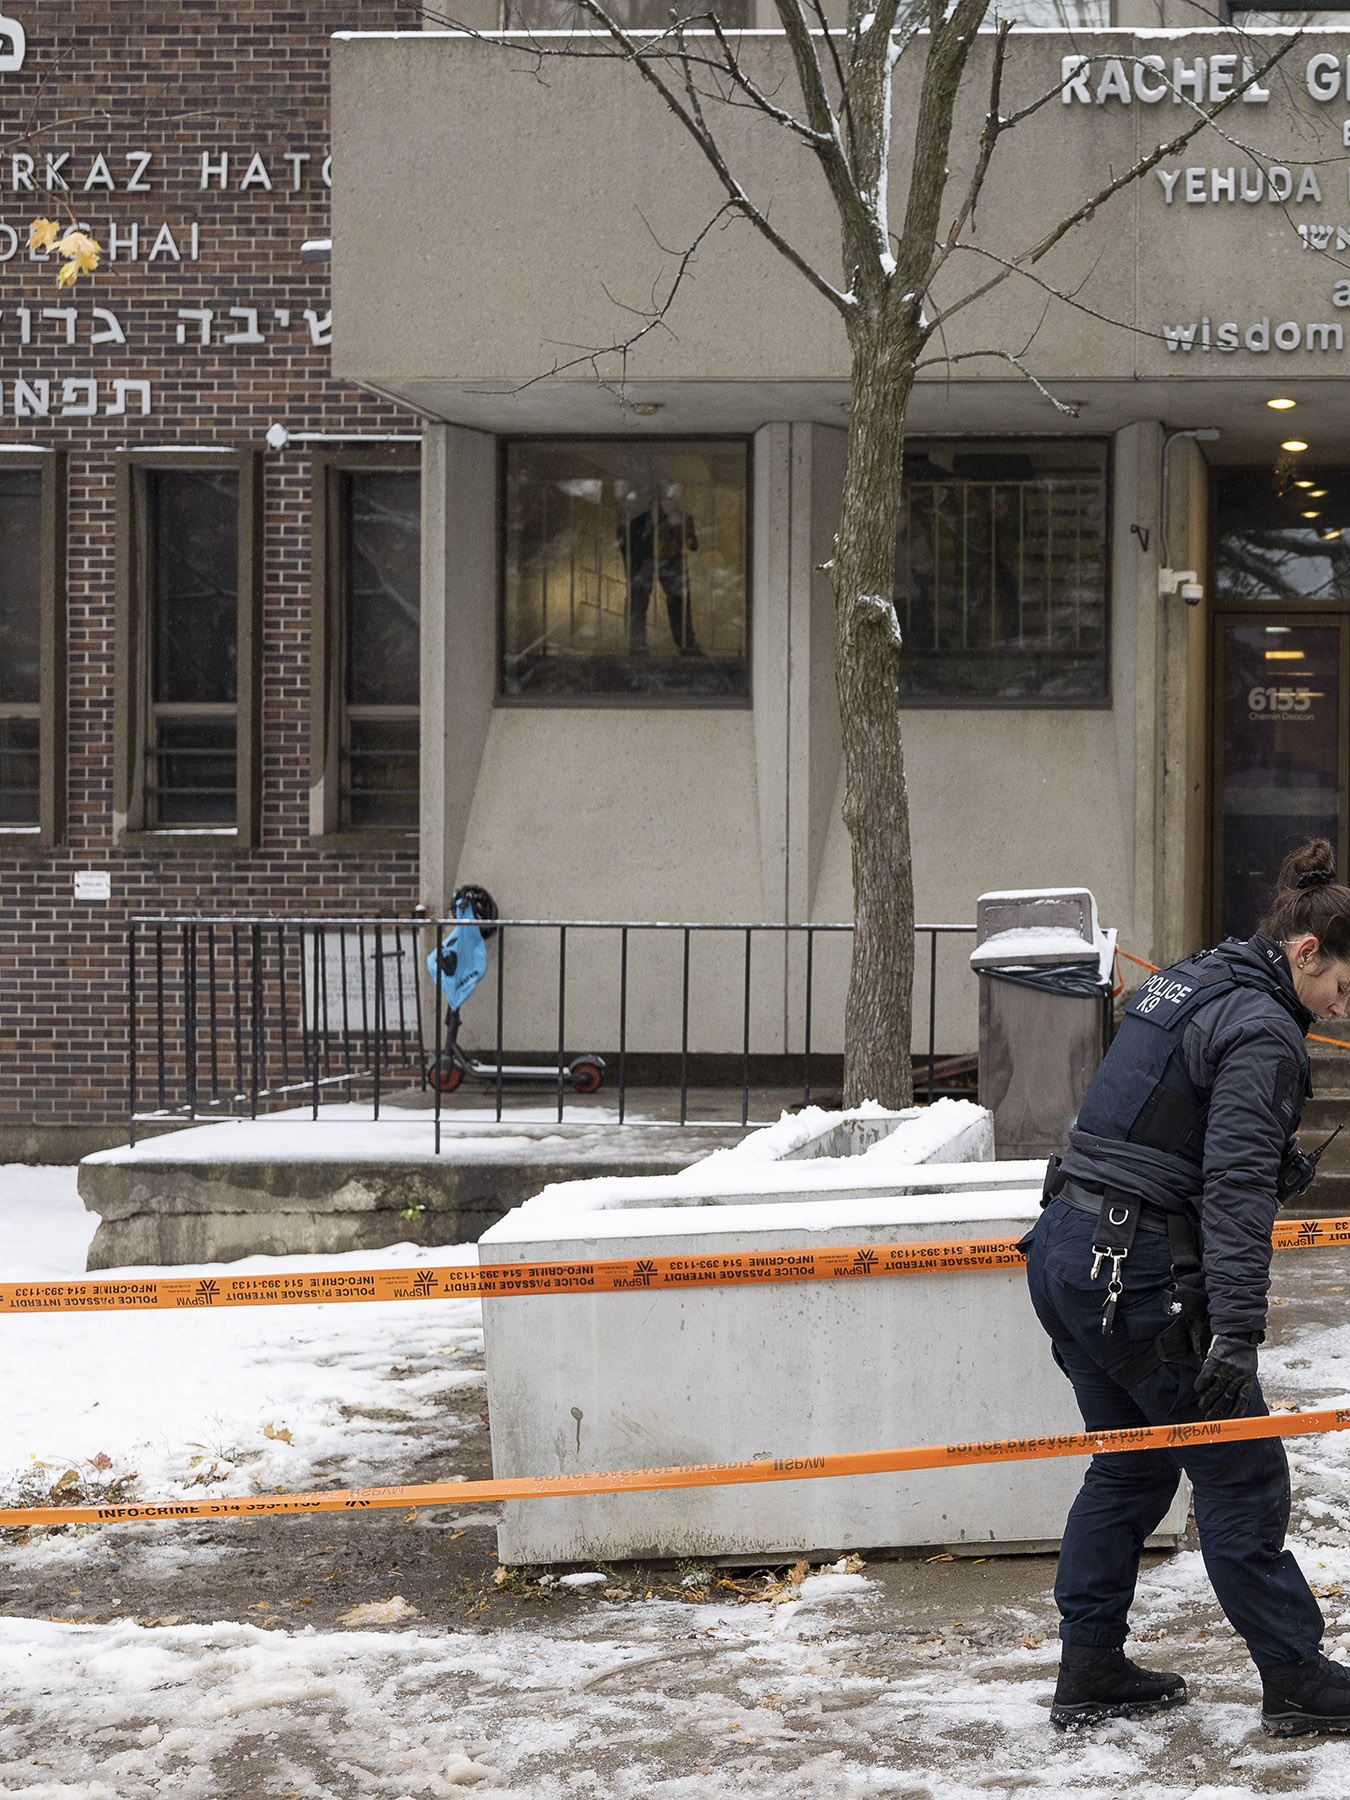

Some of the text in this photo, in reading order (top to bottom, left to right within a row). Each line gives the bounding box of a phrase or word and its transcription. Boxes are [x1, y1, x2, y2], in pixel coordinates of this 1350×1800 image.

[1061, 54, 1270, 105] RACHEL
[0, 151, 152, 192] RKAZ
[1155, 166, 1322, 203] YEHUDA
[0, 307, 126, 346] גדו
[1162, 316, 1343, 351] wisdom
[0, 378, 151, 417] תפא
[1248, 686, 1312, 712] 6155
[1248, 712, 1281, 721] Chemin
[1139, 975, 1193, 1005] POLICE
[1136, 994, 1159, 1014] K9
[1278, 1234, 1307, 1248] SPVM
[891, 1248, 939, 1259] 393-1133
[970, 1243, 1017, 1255] O-CRIME
[670, 1259, 718, 1271] 393-1133
[723, 1258, 741, 1268] 514
[749, 1254, 813, 1268] INFO-CRIME
[884, 1252, 1028, 1271] OLICE PASSAGE INTERDIT
[450, 1269, 499, 1281] 393-1133
[503, 1269, 521, 1279] 514
[664, 1265, 815, 1282] POLICE PASSAGE INTERDIT
[834, 1262, 863, 1277] SPVM
[233, 1279, 280, 1290] 393-1133
[285, 1279, 303, 1288] 514
[444, 1276, 594, 1293] POLICE PASSAGE INTERDIT
[614, 1273, 643, 1288] SPVM
[16, 1287, 63, 1297] 393-1133
[68, 1286, 85, 1295] 514
[226, 1286, 375, 1301] POLICE PASSAGE INTERDIT
[394, 1284, 423, 1298] SPVM
[10, 1295, 158, 1308] POLICE PASSAGE INTERDIT
[177, 1292, 205, 1306] SPVM
[98, 1504, 200, 1519] INFO-CRIME
